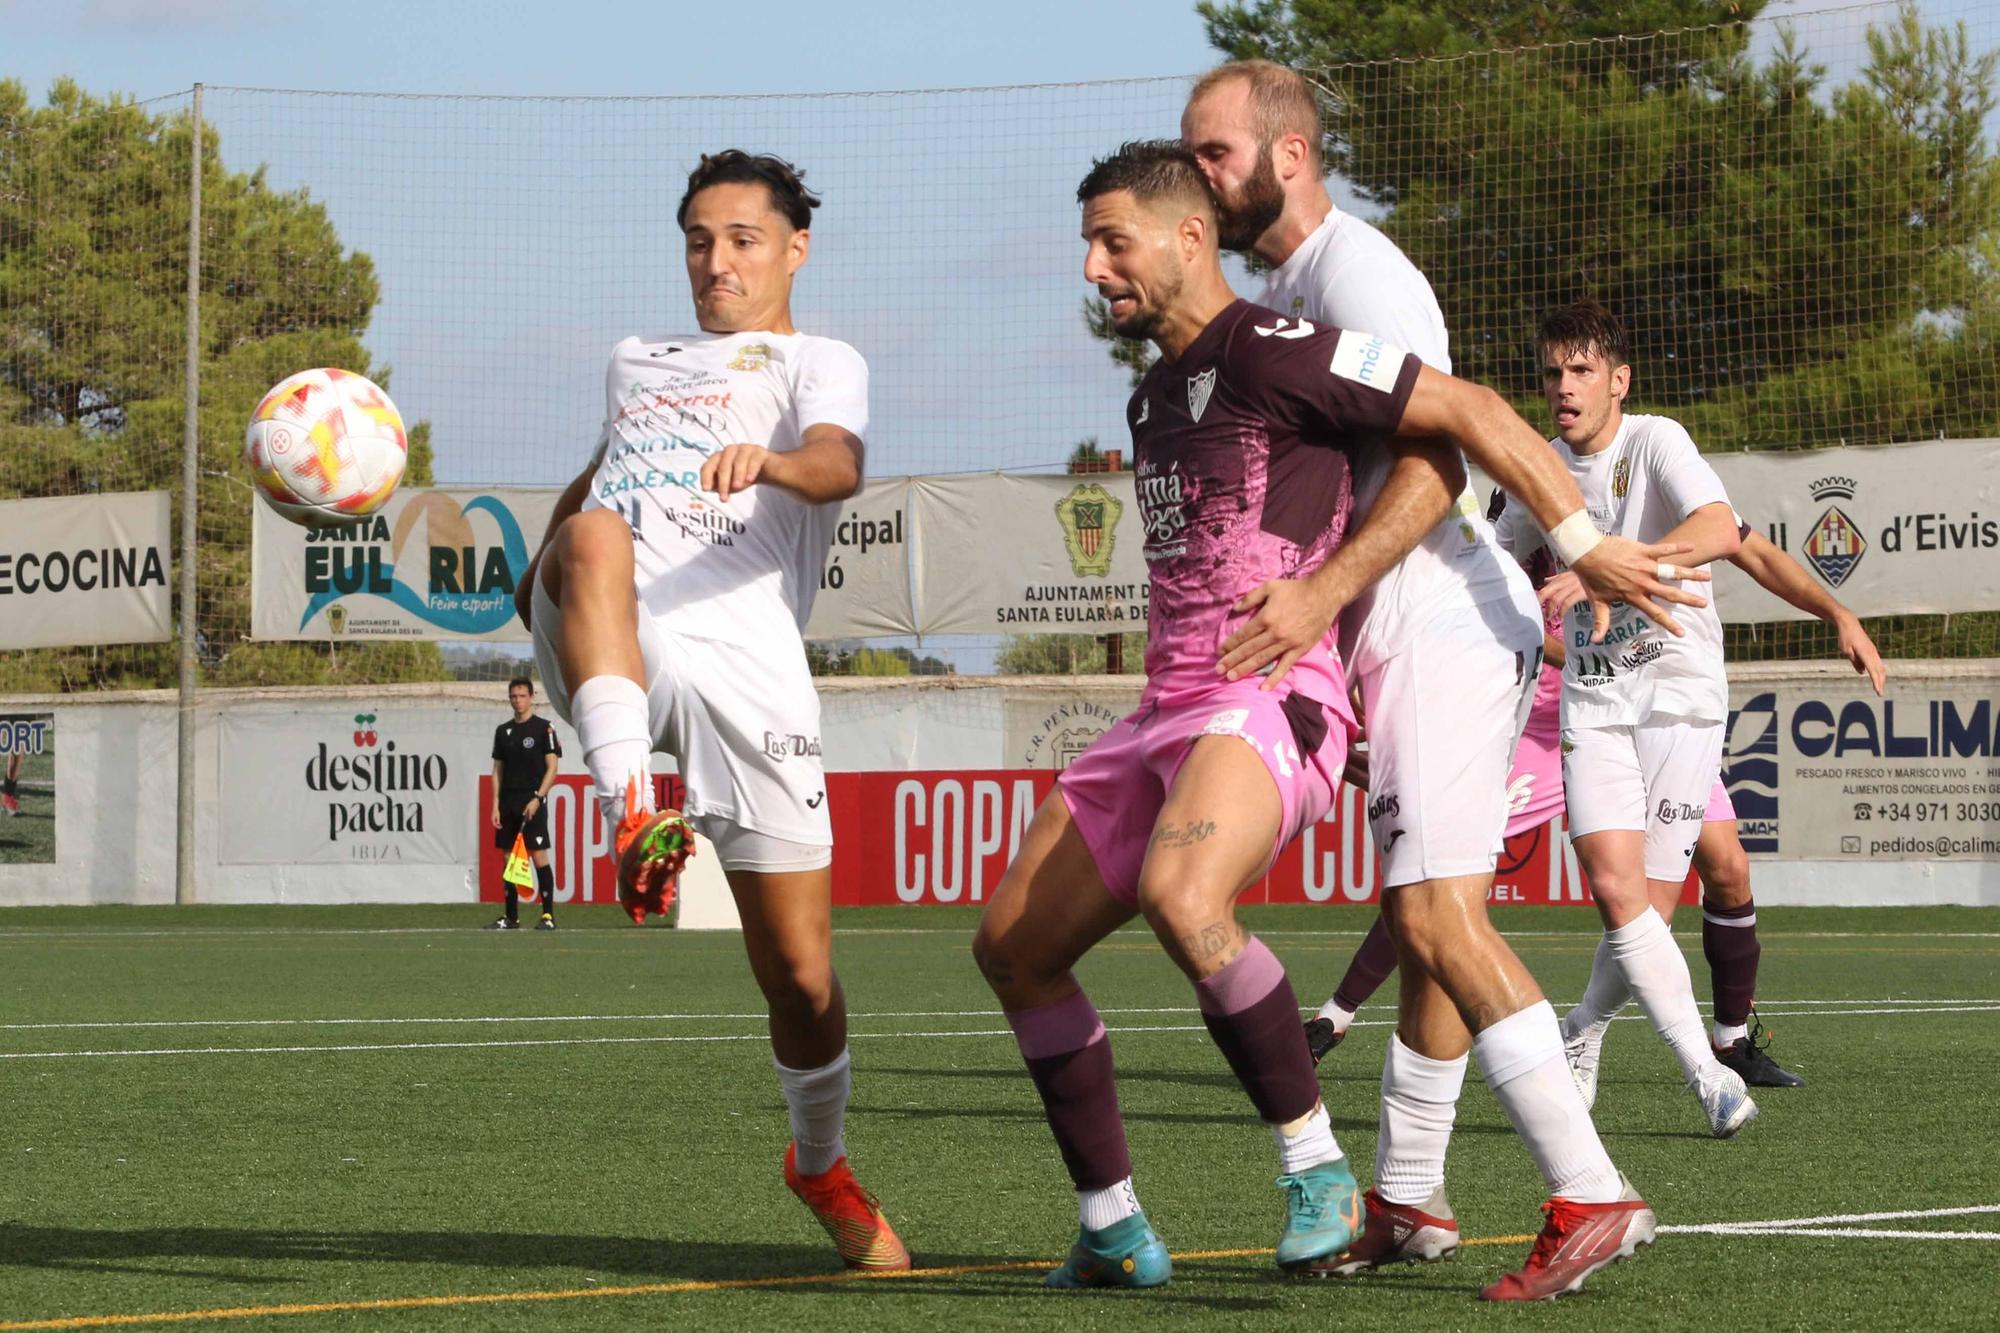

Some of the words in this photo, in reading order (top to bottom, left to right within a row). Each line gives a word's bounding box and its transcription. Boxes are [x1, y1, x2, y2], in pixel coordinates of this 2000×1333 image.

[832, 510, 902, 553] cipal
[1025, 584, 1136, 602] AJUNTAMENT
[462, 595, 504, 617] esport!
[997, 607, 1050, 623] SANTA
[1791, 700, 2000, 758] CALIM
[759, 731, 788, 763] Las
[305, 740, 448, 793] destino
[1796, 768, 1843, 778] PESCADO
[1845, 768, 1885, 778] FRESCO
[1885, 768, 1893, 778] Y
[1894, 768, 1940, 778] MARISCO
[1942, 768, 1967, 778] VIVO
[1842, 785, 1899, 794] ALIMENTOS
[1901, 785, 1970, 794] CONGELADOS
[1972, 785, 1986, 794] EN
[329, 794, 424, 841] pacha
[1657, 799, 1678, 824] Las
[1877, 803, 1911, 821] +34
[1916, 803, 1949, 821] 971
[352, 844, 402, 859] IBIZA
